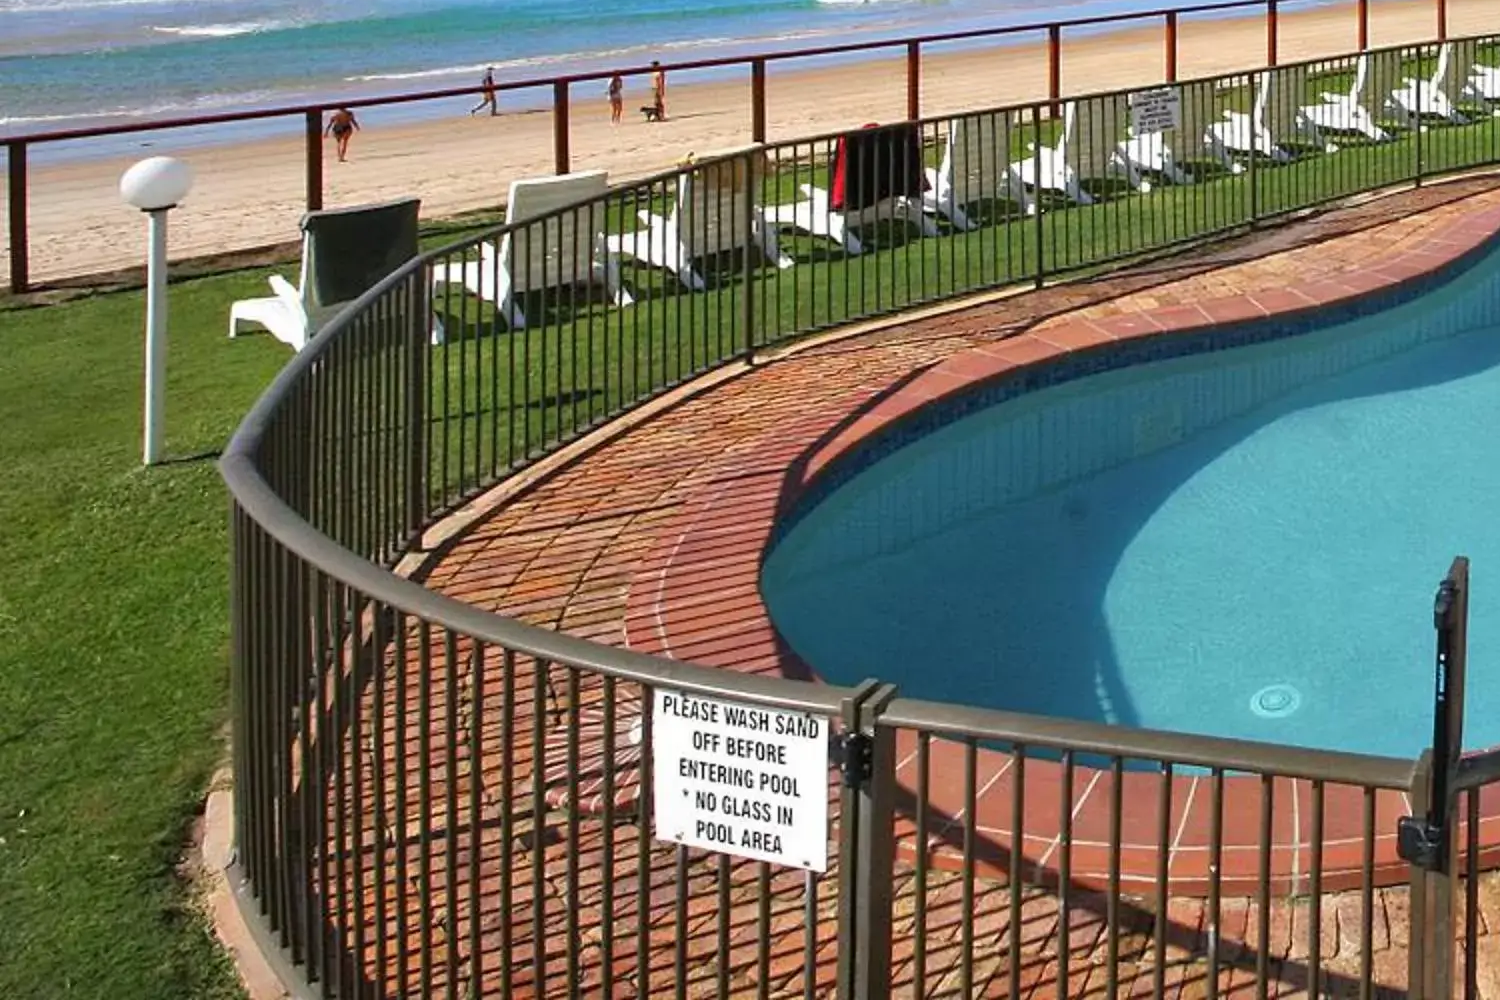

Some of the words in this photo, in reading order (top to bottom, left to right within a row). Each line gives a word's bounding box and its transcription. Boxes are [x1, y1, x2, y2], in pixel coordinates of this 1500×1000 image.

[663, 695, 719, 723] PLEASE
[724, 706, 769, 732] WASH
[775, 714, 819, 739] SAND
[693, 730, 720, 752] OFF
[726, 736, 787, 765] BEFORE
[679, 757, 754, 789] ENTERING
[759, 772, 801, 798] POOL
[695, 790, 717, 812] NO
[722, 795, 771, 823] GLASS
[777, 805, 793, 826] IN
[696, 819, 735, 845] POOL
[741, 829, 783, 854] AREA
